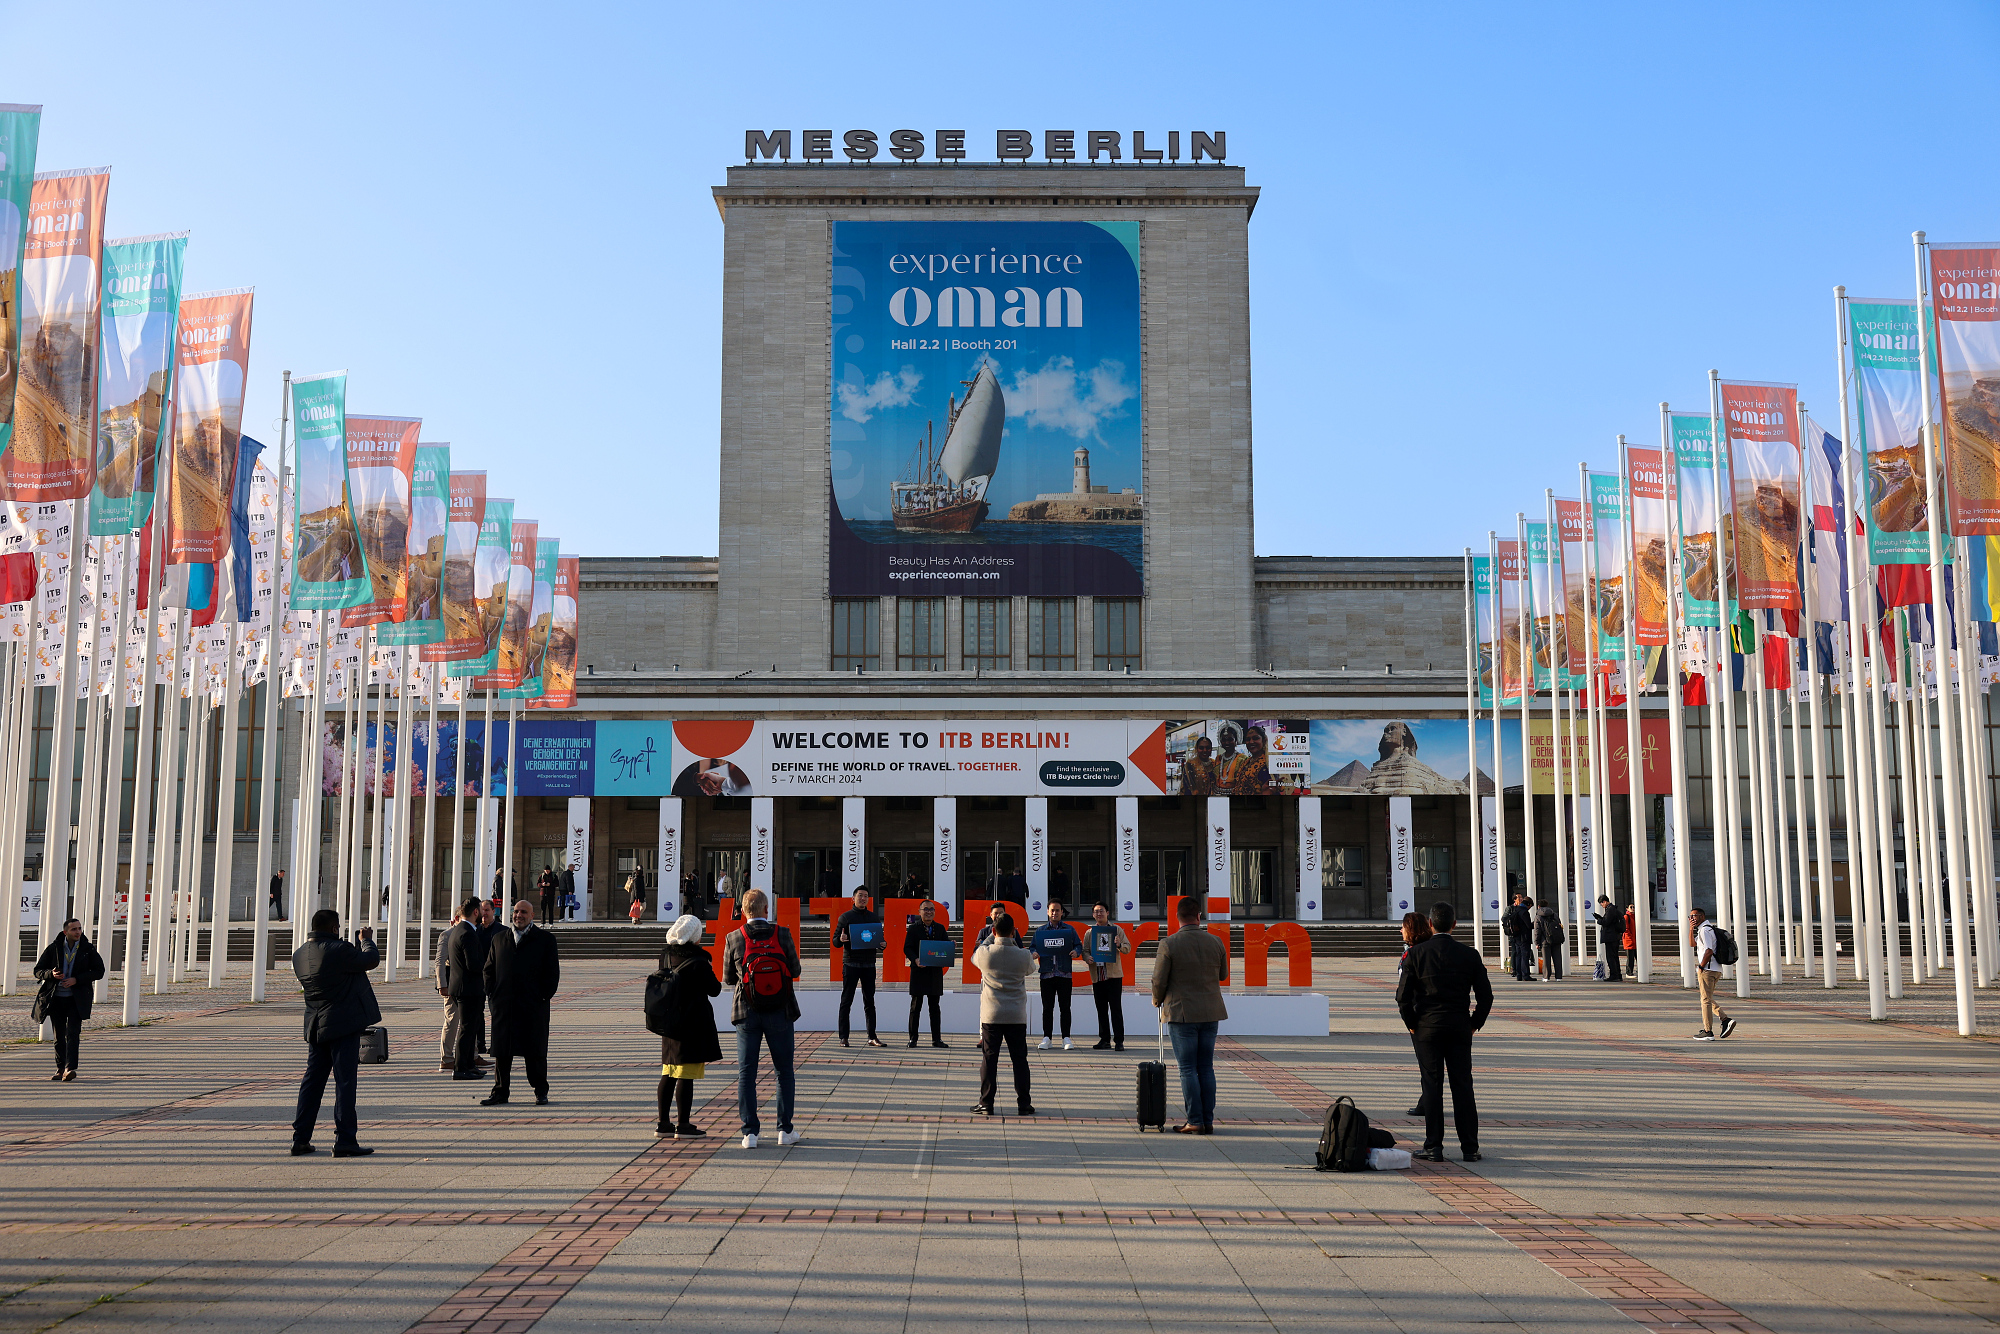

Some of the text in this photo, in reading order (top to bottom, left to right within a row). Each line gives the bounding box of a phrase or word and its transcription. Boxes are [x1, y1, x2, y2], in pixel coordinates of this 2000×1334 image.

[745, 130, 1227, 160] MESSE BERLIN
[47, 239, 68, 248] Booth
[69, 238, 83, 246] 201
[107, 259, 168, 276] experience
[889, 246, 1083, 281] experience
[107, 273, 168, 294] oman
[1940, 282, 2000, 300] oma
[107, 298, 119, 309] Hall
[119, 298, 130, 307] 2.2
[153, 296, 166, 304] 201
[889, 286, 1083, 328] oman
[182, 311, 233, 328] experience
[181, 324, 232, 345] oman
[891, 338, 916, 350] Hall
[919, 338, 940, 350] 2.2
[952, 338, 992, 350] Booth
[995, 338, 1017, 350] 201
[182, 350, 194, 358] Hall
[299, 393, 335, 407] experience
[1729, 399, 1782, 409] experience
[301, 404, 336, 421] oman
[1731, 409, 1784, 425] oman
[347, 430, 402, 440] experience
[346, 440, 401, 453] oman
[7, 470, 25, 479] Eine
[252, 475, 266, 483] ITB
[38, 505, 56, 515] ITB
[98, 507, 120, 515] Beauty
[251, 513, 265, 521] ITB
[57, 525, 69, 538] ITB
[263, 529, 275, 538] ITB
[5, 535, 23, 546] ITB
[255, 551, 268, 559] ITB
[889, 555, 1015, 569] Beauty Has An Address
[889, 570, 1000, 582] experienceoman.om
[47, 588, 61, 598] ITB
[258, 588, 272, 597] ITB
[261, 624, 271, 633] ITB
[299, 621, 312, 629] ITB
[132, 628, 146, 636] ITB
[212, 639, 226, 647] ITB
[308, 642, 319, 650] ITB
[101, 659, 112, 667] ITB
[346, 655, 358, 663] ITB
[544, 737, 592, 749] ERWARTUNGEN
[772, 732, 1069, 749] WELCOME TO ITB BERLIN!
[1291, 736, 1307, 744] ITB
[566, 749, 581, 760] DER
[579, 760, 588, 771] AN
[772, 762, 1021, 771] DEFINE THE WORLD OF TRAVEL. TOGETHER.
[772, 774, 778, 784] 5
[789, 774, 795, 784] 7
[798, 774, 836, 784] MARCH
[839, 774, 862, 784] 2024
[1058, 773, 1081, 781] Buyers
[573, 840, 582, 872] QATAR
[665, 840, 674, 872] QATAR
[757, 840, 766, 872] QATAR
[849, 840, 858, 872] QATAR
[940, 840, 950, 872] QATAR
[1032, 840, 1041, 872] QATAR
[1123, 840, 1132, 872] QATAR
[1215, 839, 1224, 871] QATAR
[1306, 839, 1315, 871] QATAR
[1397, 839, 1406, 871] QATAR
[1489, 839, 1498, 870] QATAR
